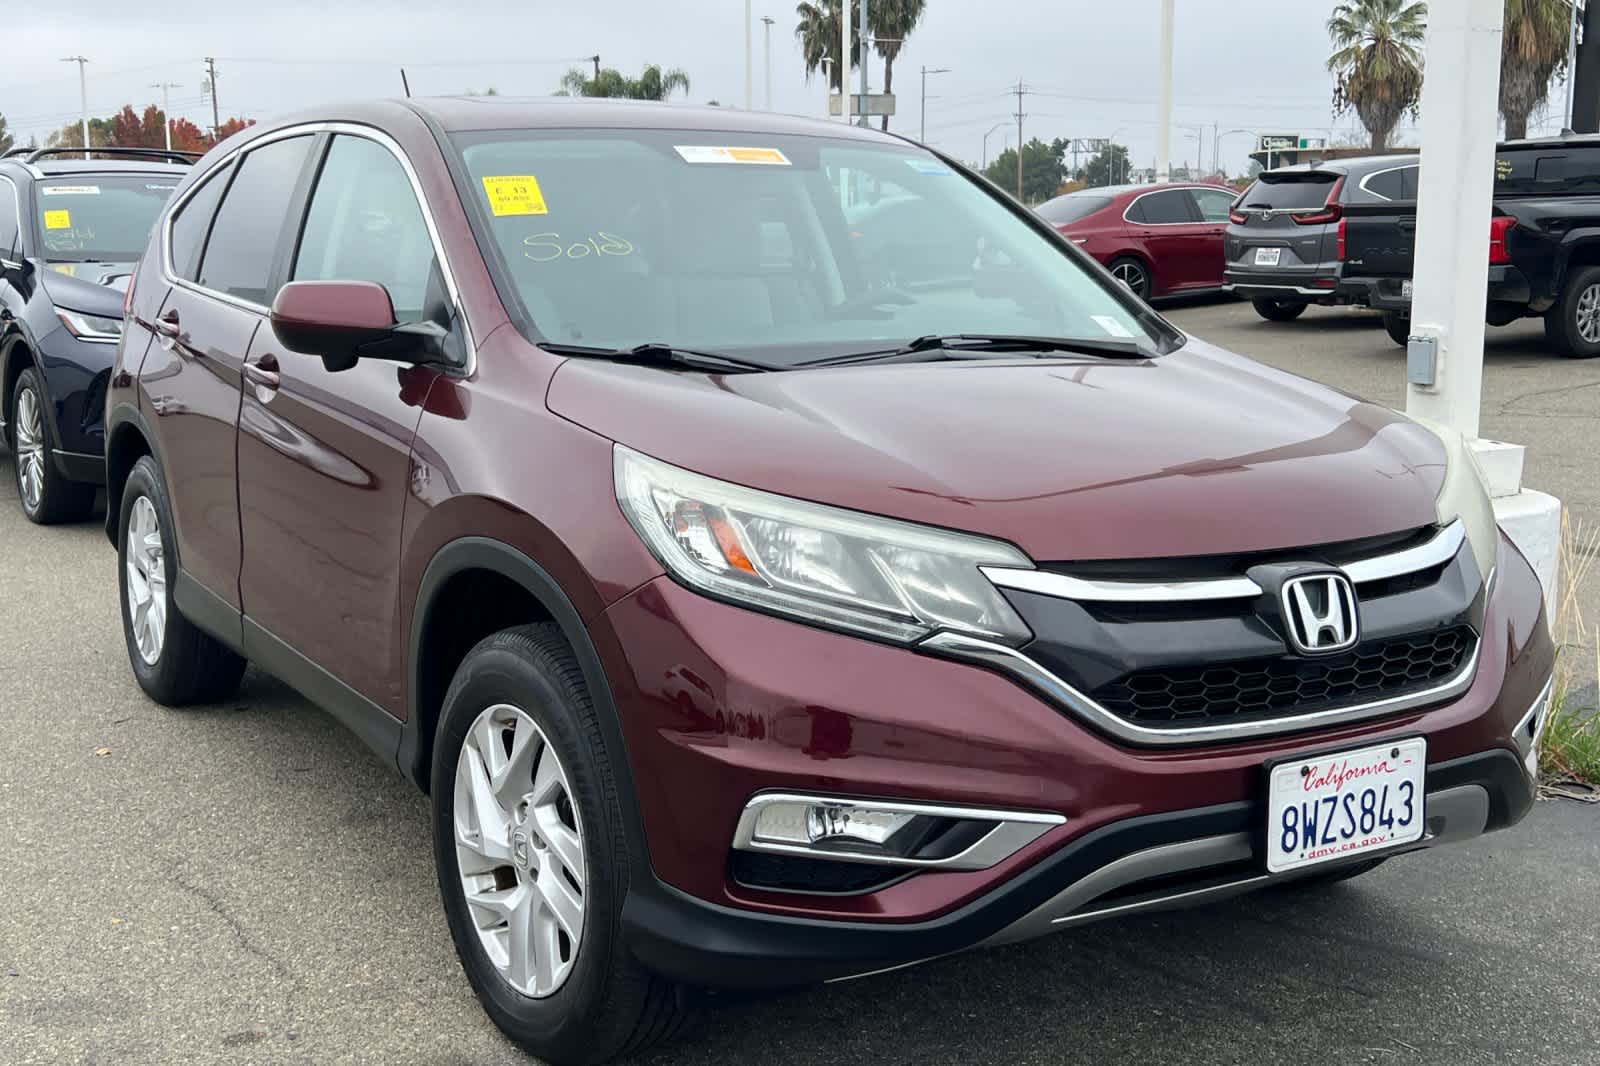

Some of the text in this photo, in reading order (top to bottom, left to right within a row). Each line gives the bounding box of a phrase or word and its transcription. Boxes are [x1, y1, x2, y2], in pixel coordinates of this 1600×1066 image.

[523, 231, 633, 262] Sold
[1303, 759, 1397, 792] California
[1280, 780, 1414, 853] 8WZS843
[1307, 834, 1386, 860] dmv.ca.gov
